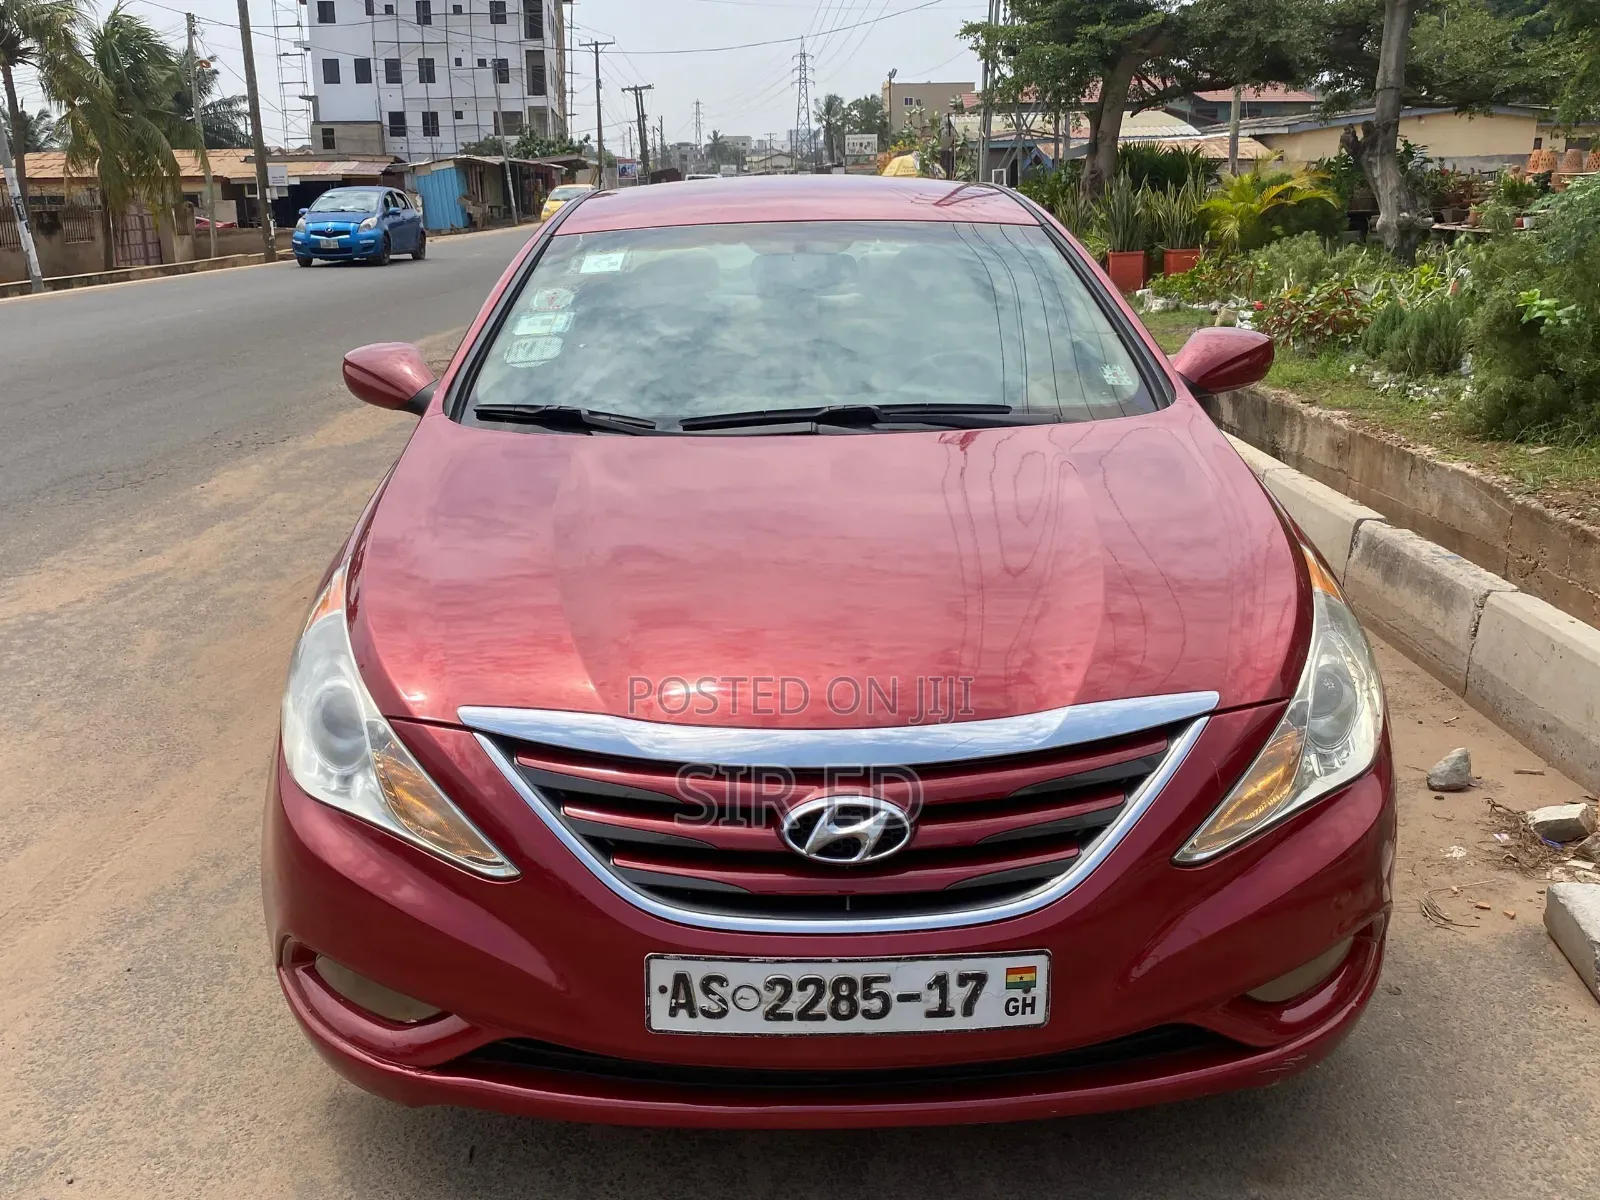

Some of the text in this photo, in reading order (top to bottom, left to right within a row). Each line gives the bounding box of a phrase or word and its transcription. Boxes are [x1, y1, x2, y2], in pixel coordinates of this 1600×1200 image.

[668, 969, 990, 1022] AS 2285-17
[1004, 996, 1037, 1017] GH
